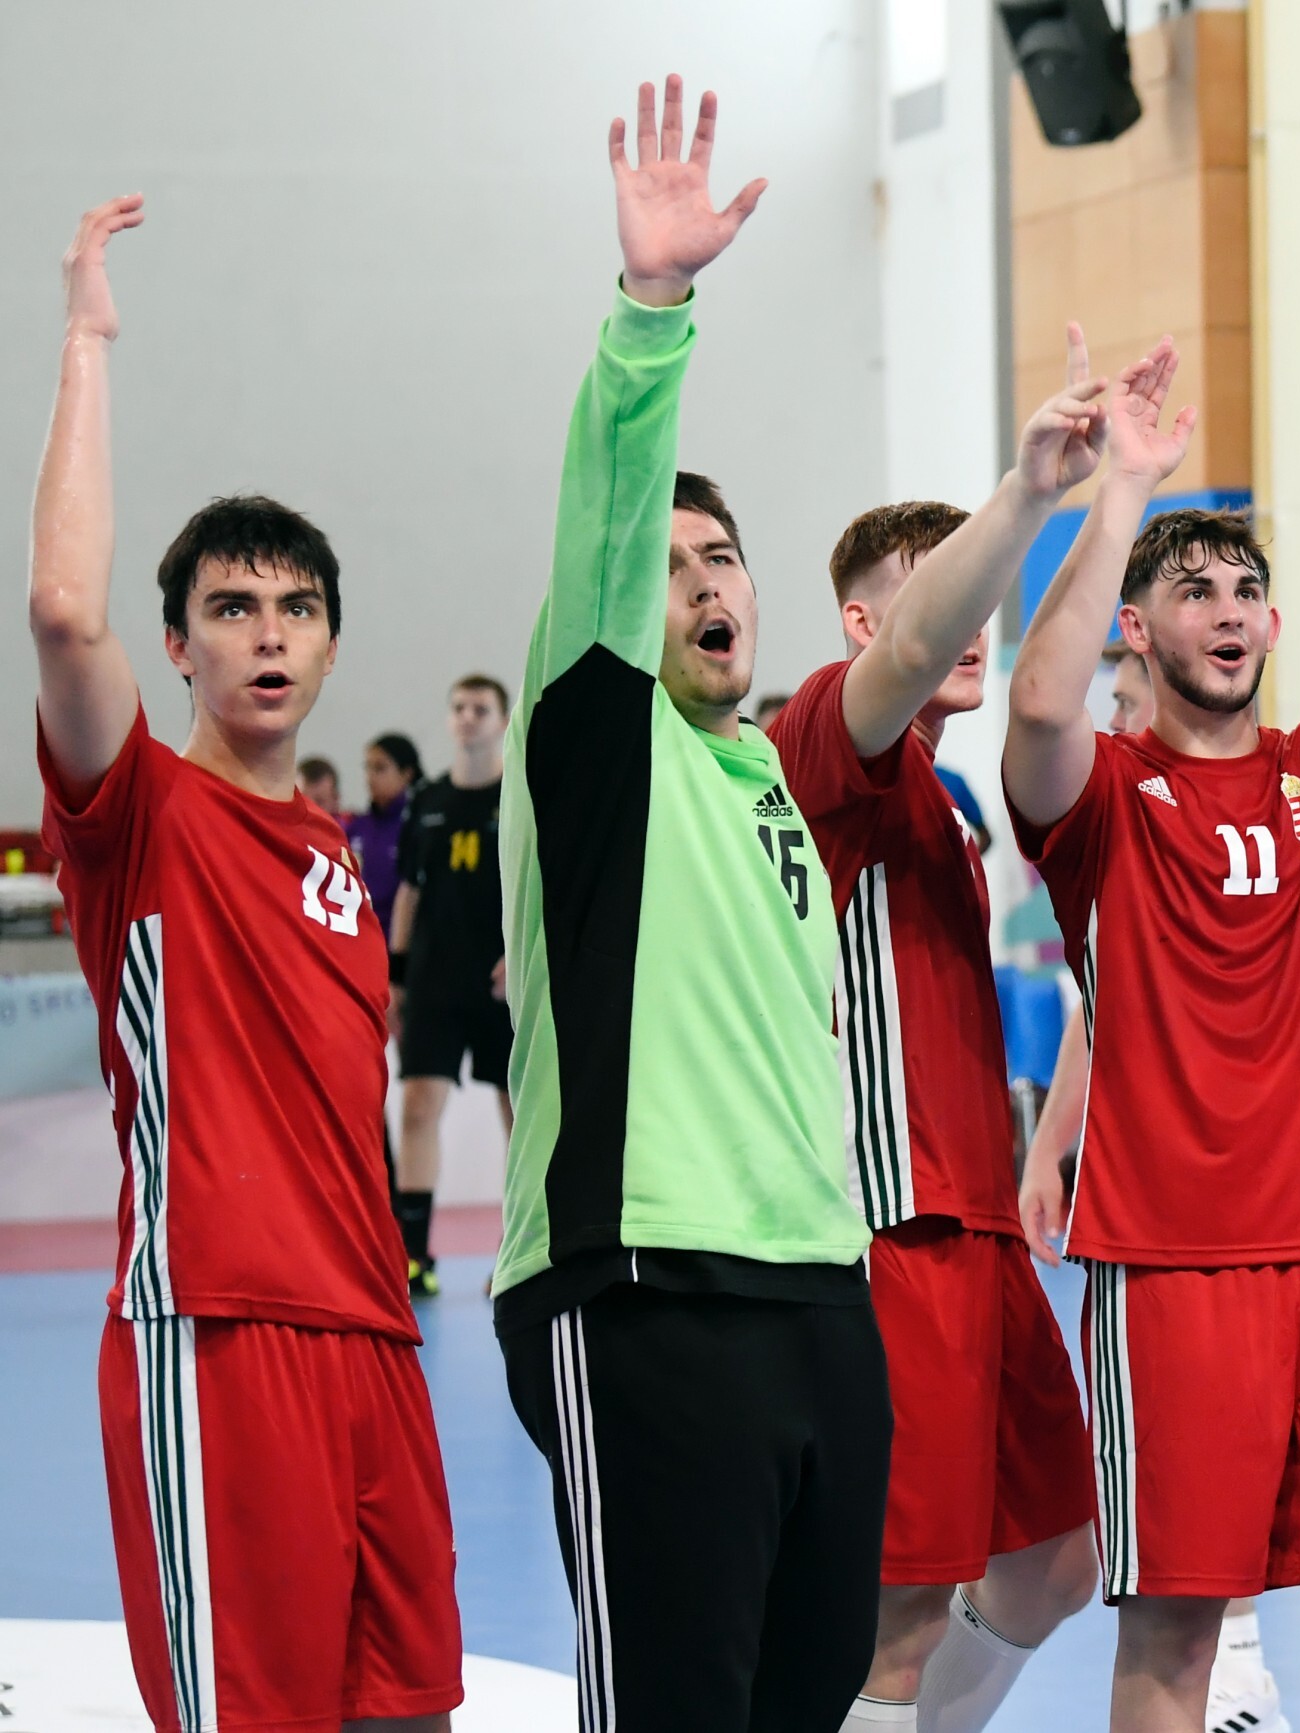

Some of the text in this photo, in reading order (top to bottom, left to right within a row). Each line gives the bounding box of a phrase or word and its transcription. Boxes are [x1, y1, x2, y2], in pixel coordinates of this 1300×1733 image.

[1138, 782, 1178, 807] adidas
[752, 804, 794, 818] adidas
[1215, 824, 1280, 895] 11
